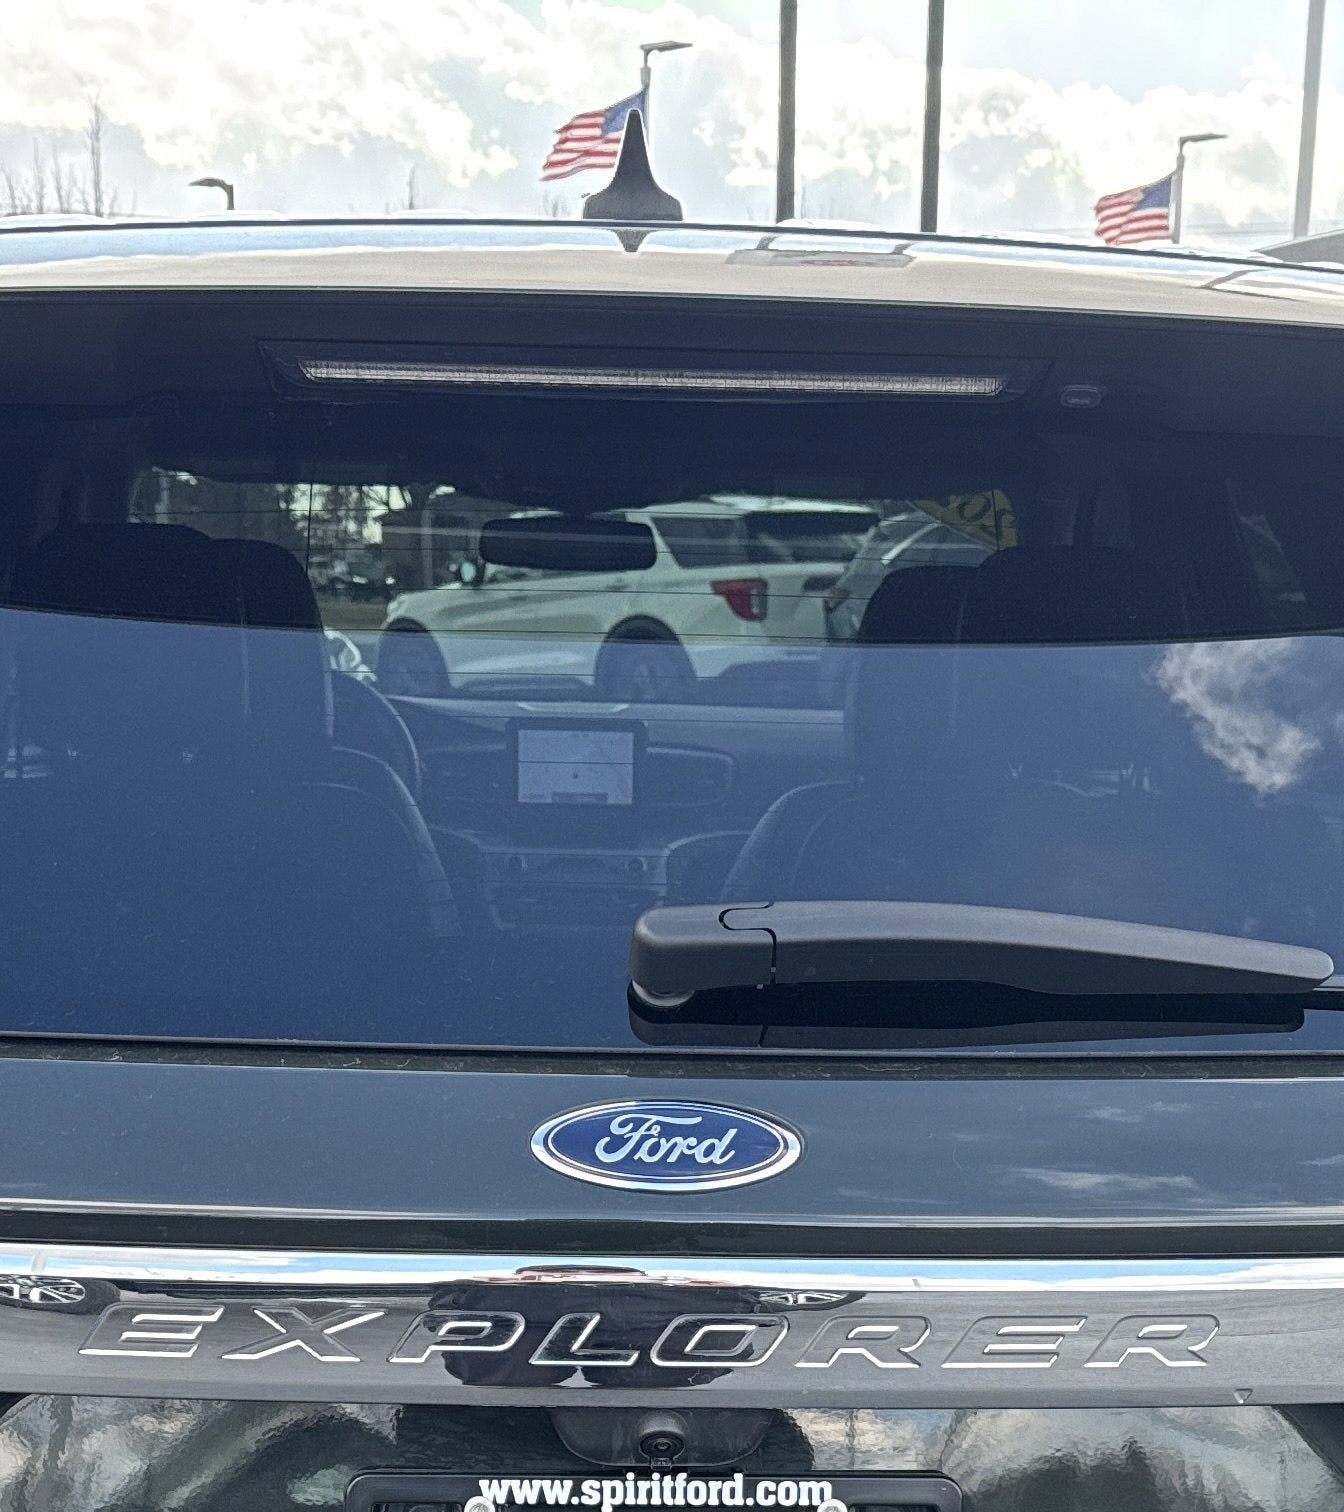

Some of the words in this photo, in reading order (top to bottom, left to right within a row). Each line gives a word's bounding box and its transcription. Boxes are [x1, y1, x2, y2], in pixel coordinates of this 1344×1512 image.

[594, 1113, 738, 1165] Ford
[77, 1306, 1221, 1374] EXPLORER
[478, 1473, 833, 1512] www.spiritford.com
